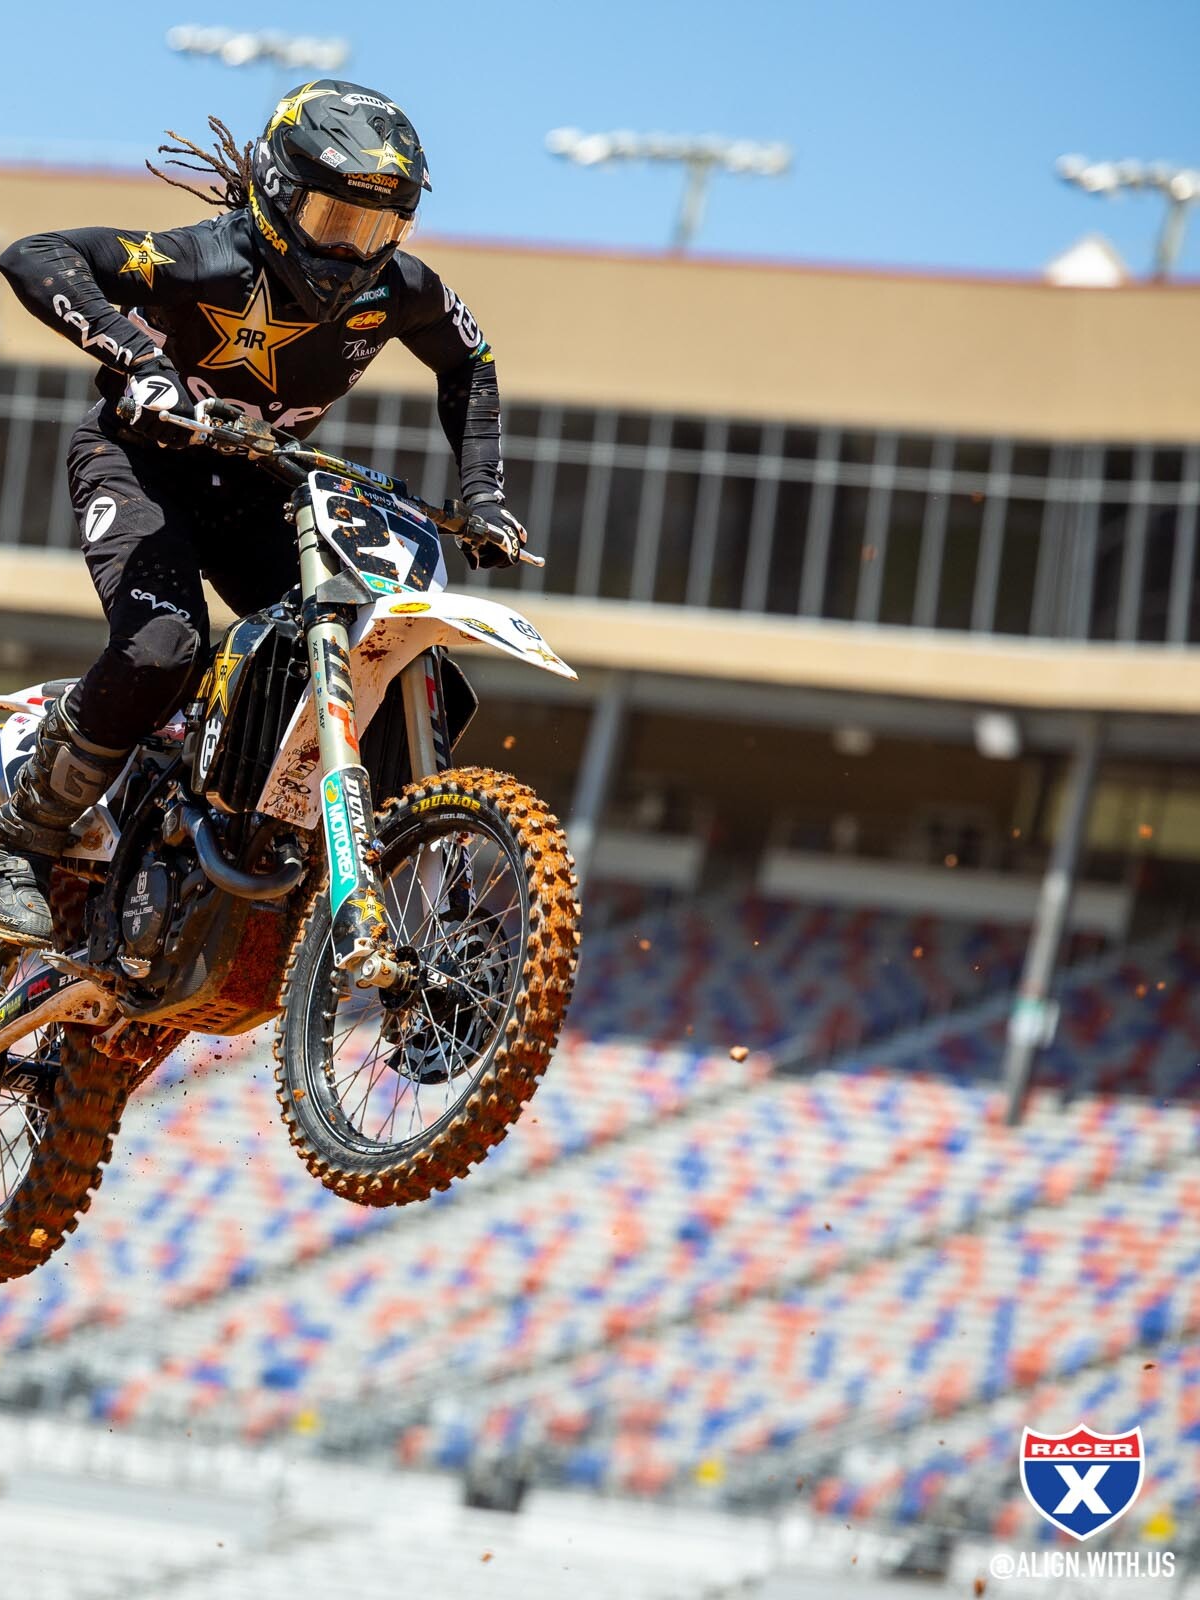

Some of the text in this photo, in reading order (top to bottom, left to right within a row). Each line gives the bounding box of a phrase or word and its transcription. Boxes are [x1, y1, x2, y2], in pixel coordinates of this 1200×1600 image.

[347, 179, 392, 194] ENERGY DRINK
[143, 380, 173, 405] 7
[88, 503, 114, 538] 7
[420, 793, 481, 813] DUNLOP
[344, 775, 375, 884] DUNLOP
[327, 805, 354, 885] MOTOREX
